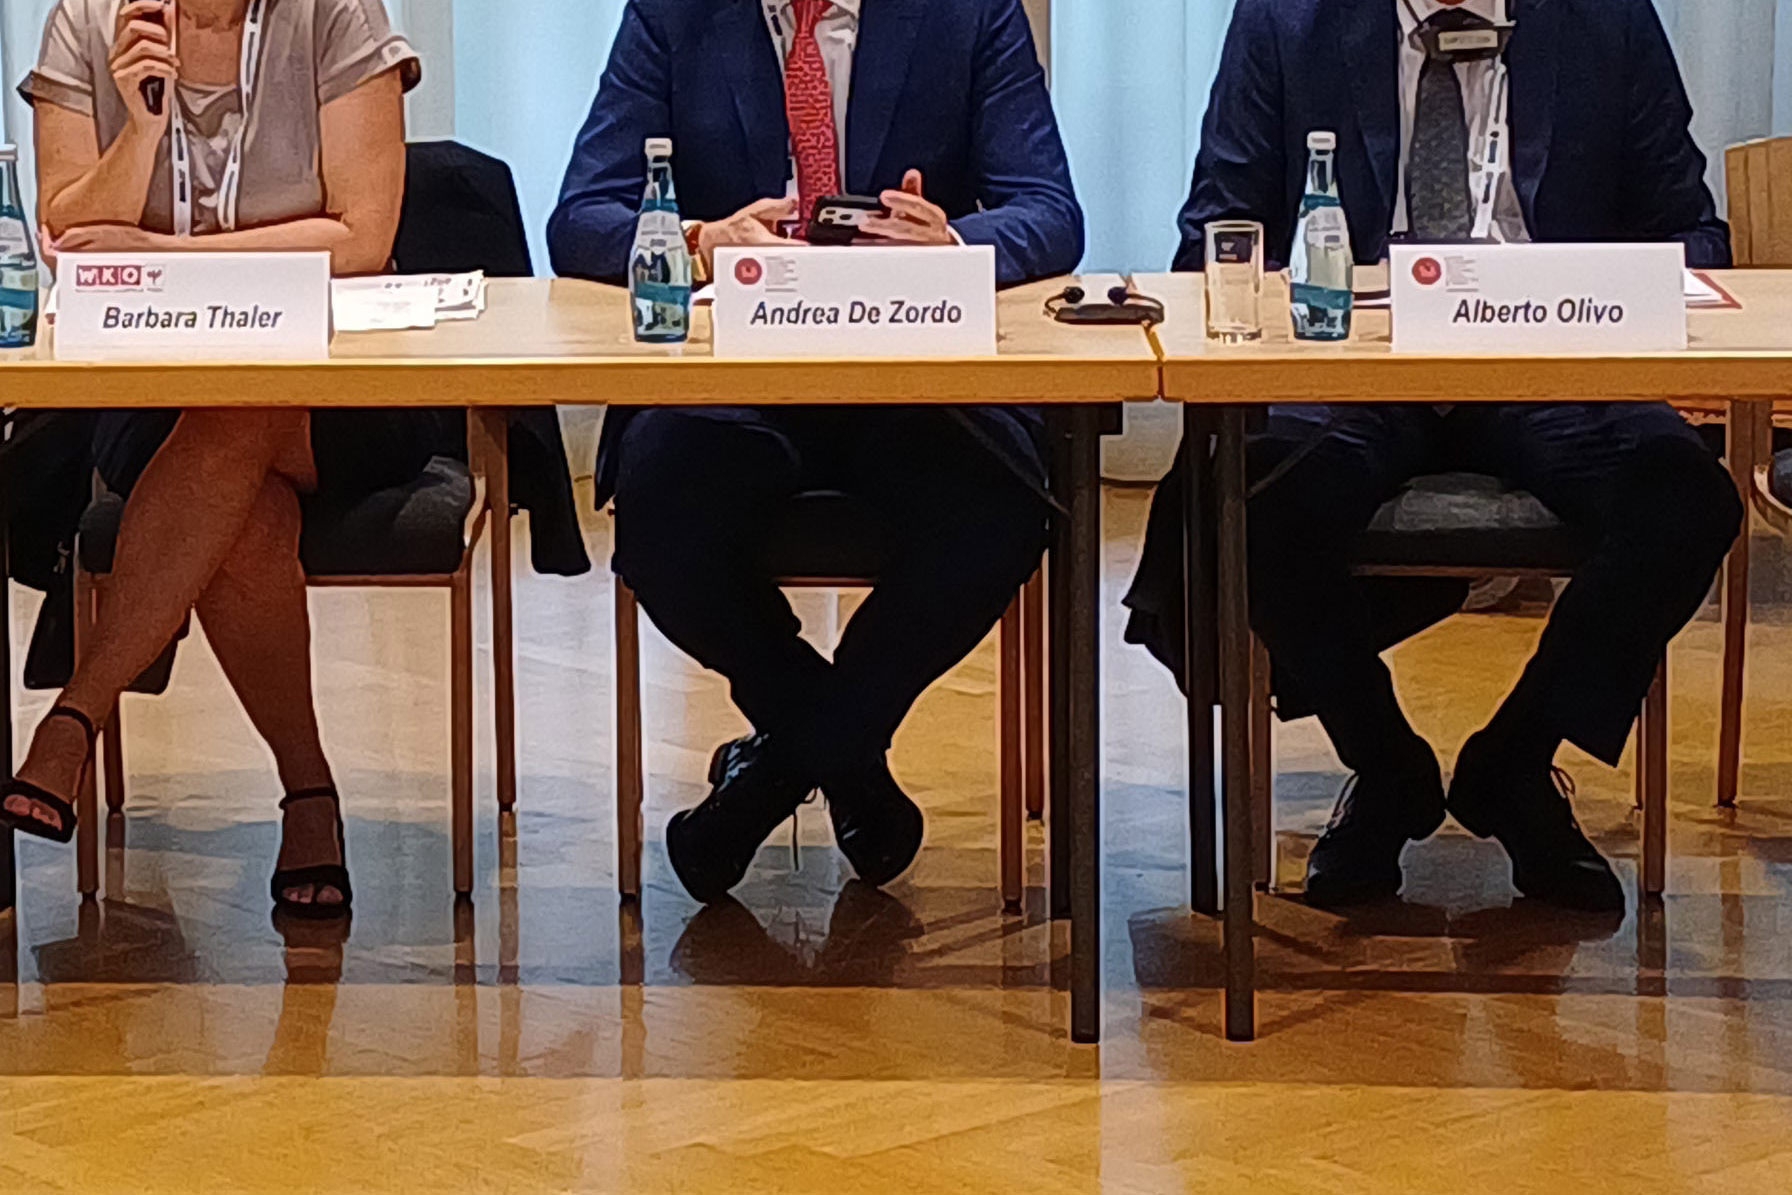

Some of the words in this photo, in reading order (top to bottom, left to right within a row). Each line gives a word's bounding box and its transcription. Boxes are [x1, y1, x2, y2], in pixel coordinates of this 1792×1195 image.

[77, 266, 141, 286] WKO
[102, 305, 198, 329] Barbara
[207, 305, 284, 329] Thaler
[749, 300, 840, 325] Andrea
[848, 300, 881, 325] De
[888, 299, 963, 324] Zordo
[1452, 297, 1548, 324] Alberto
[1557, 297, 1624, 325] Olivo
